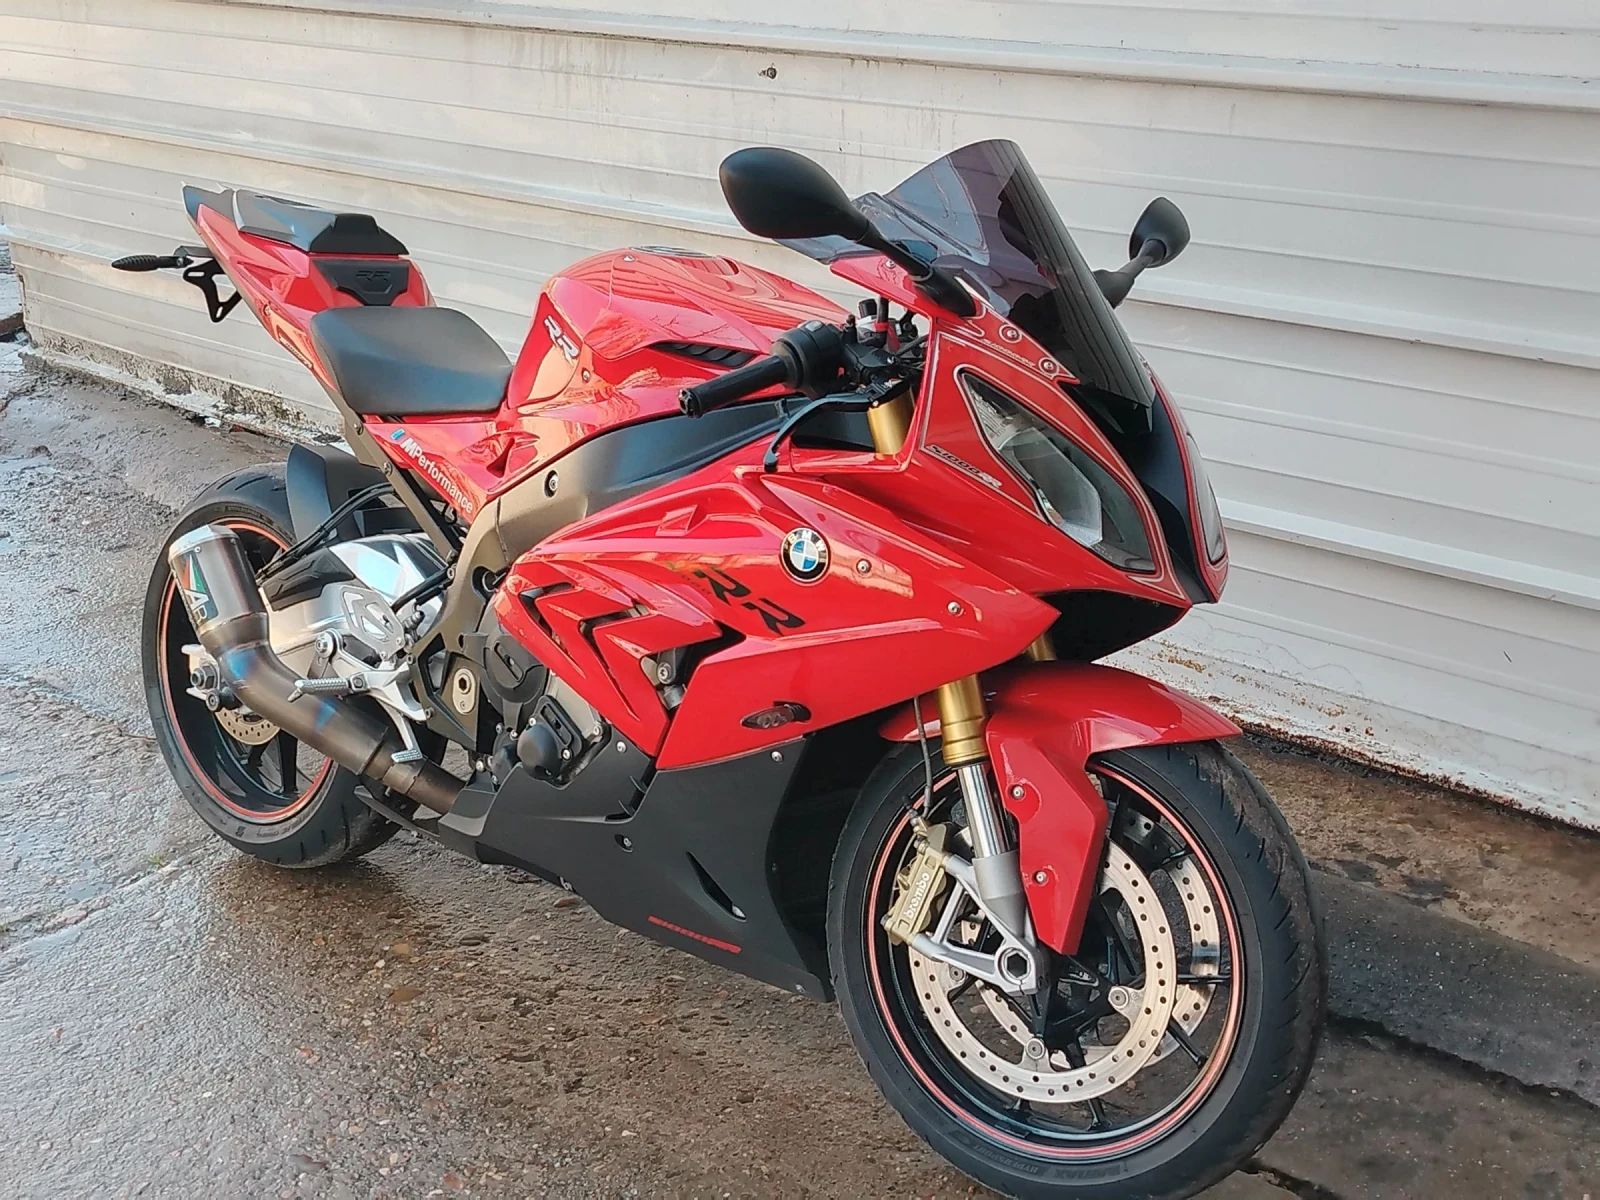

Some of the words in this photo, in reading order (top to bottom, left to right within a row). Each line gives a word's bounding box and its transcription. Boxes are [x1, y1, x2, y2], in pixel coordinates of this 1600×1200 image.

[544, 315, 580, 367] RR
[787, 530, 827, 552] BMW
[692, 565, 806, 637] RR
[903, 872, 930, 919] brembo
